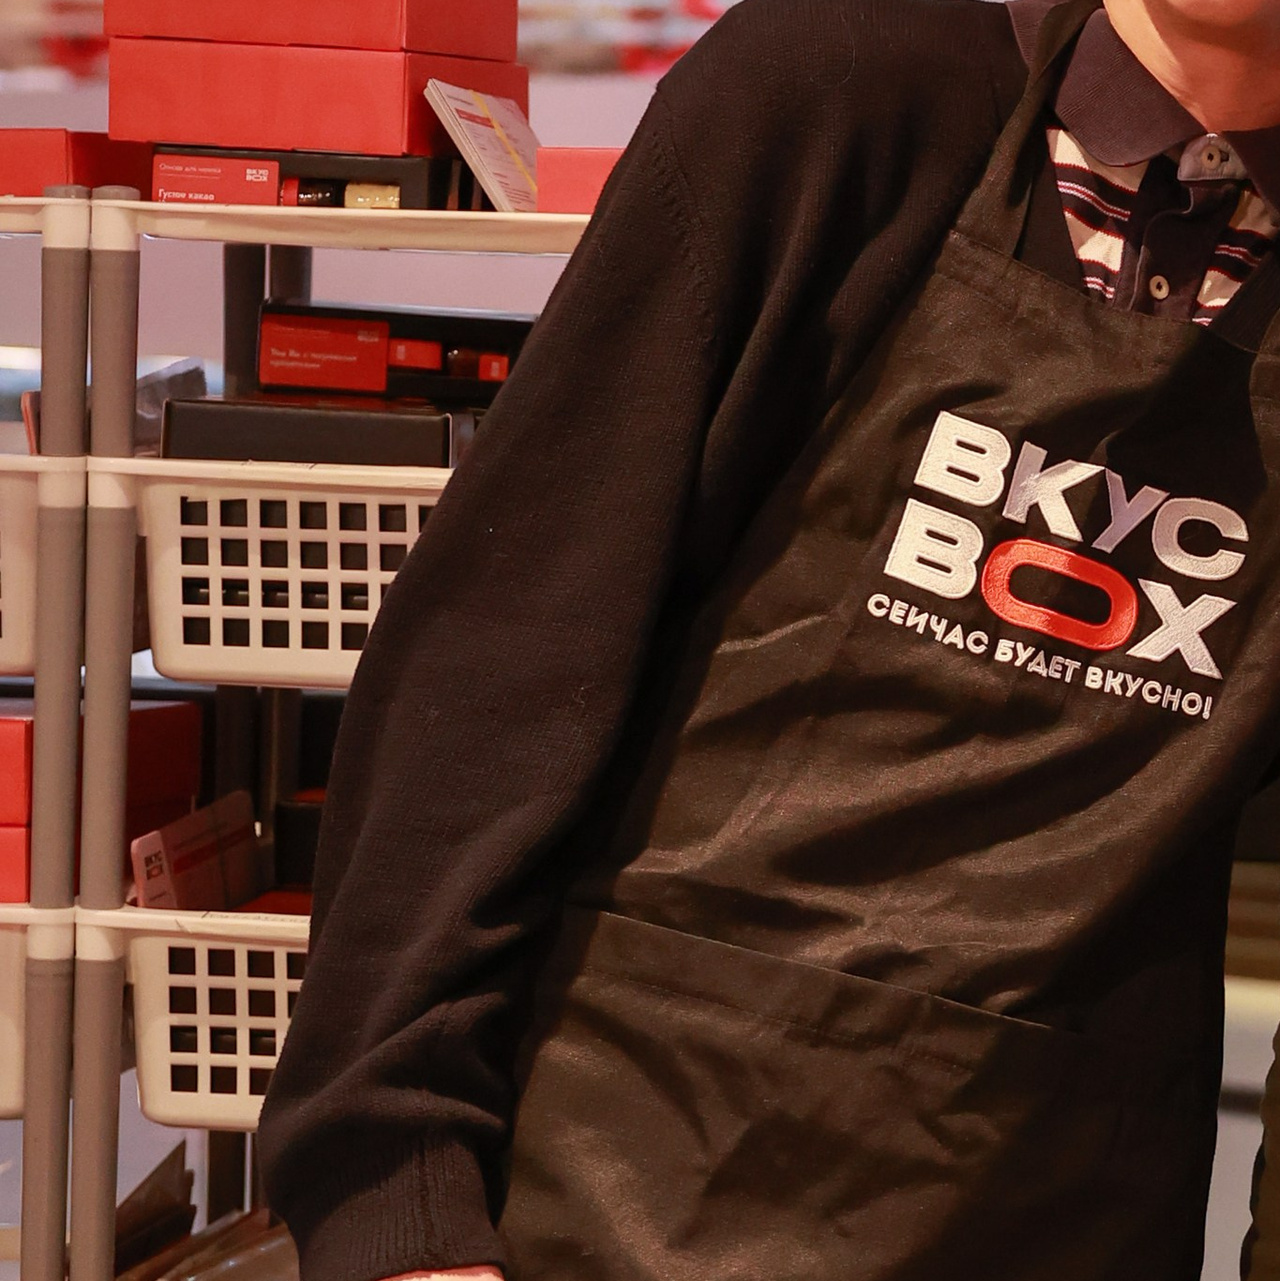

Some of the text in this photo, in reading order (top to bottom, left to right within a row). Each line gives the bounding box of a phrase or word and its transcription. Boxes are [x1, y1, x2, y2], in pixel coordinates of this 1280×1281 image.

[158, 188, 215, 201] Густое какао
[914, 410, 1249, 581] ВКУС
[884, 498, 1238, 680] BOX
[994, 639, 1081, 683] БУДЕТ
[1085, 666, 1213, 720] ВКУСНО!
